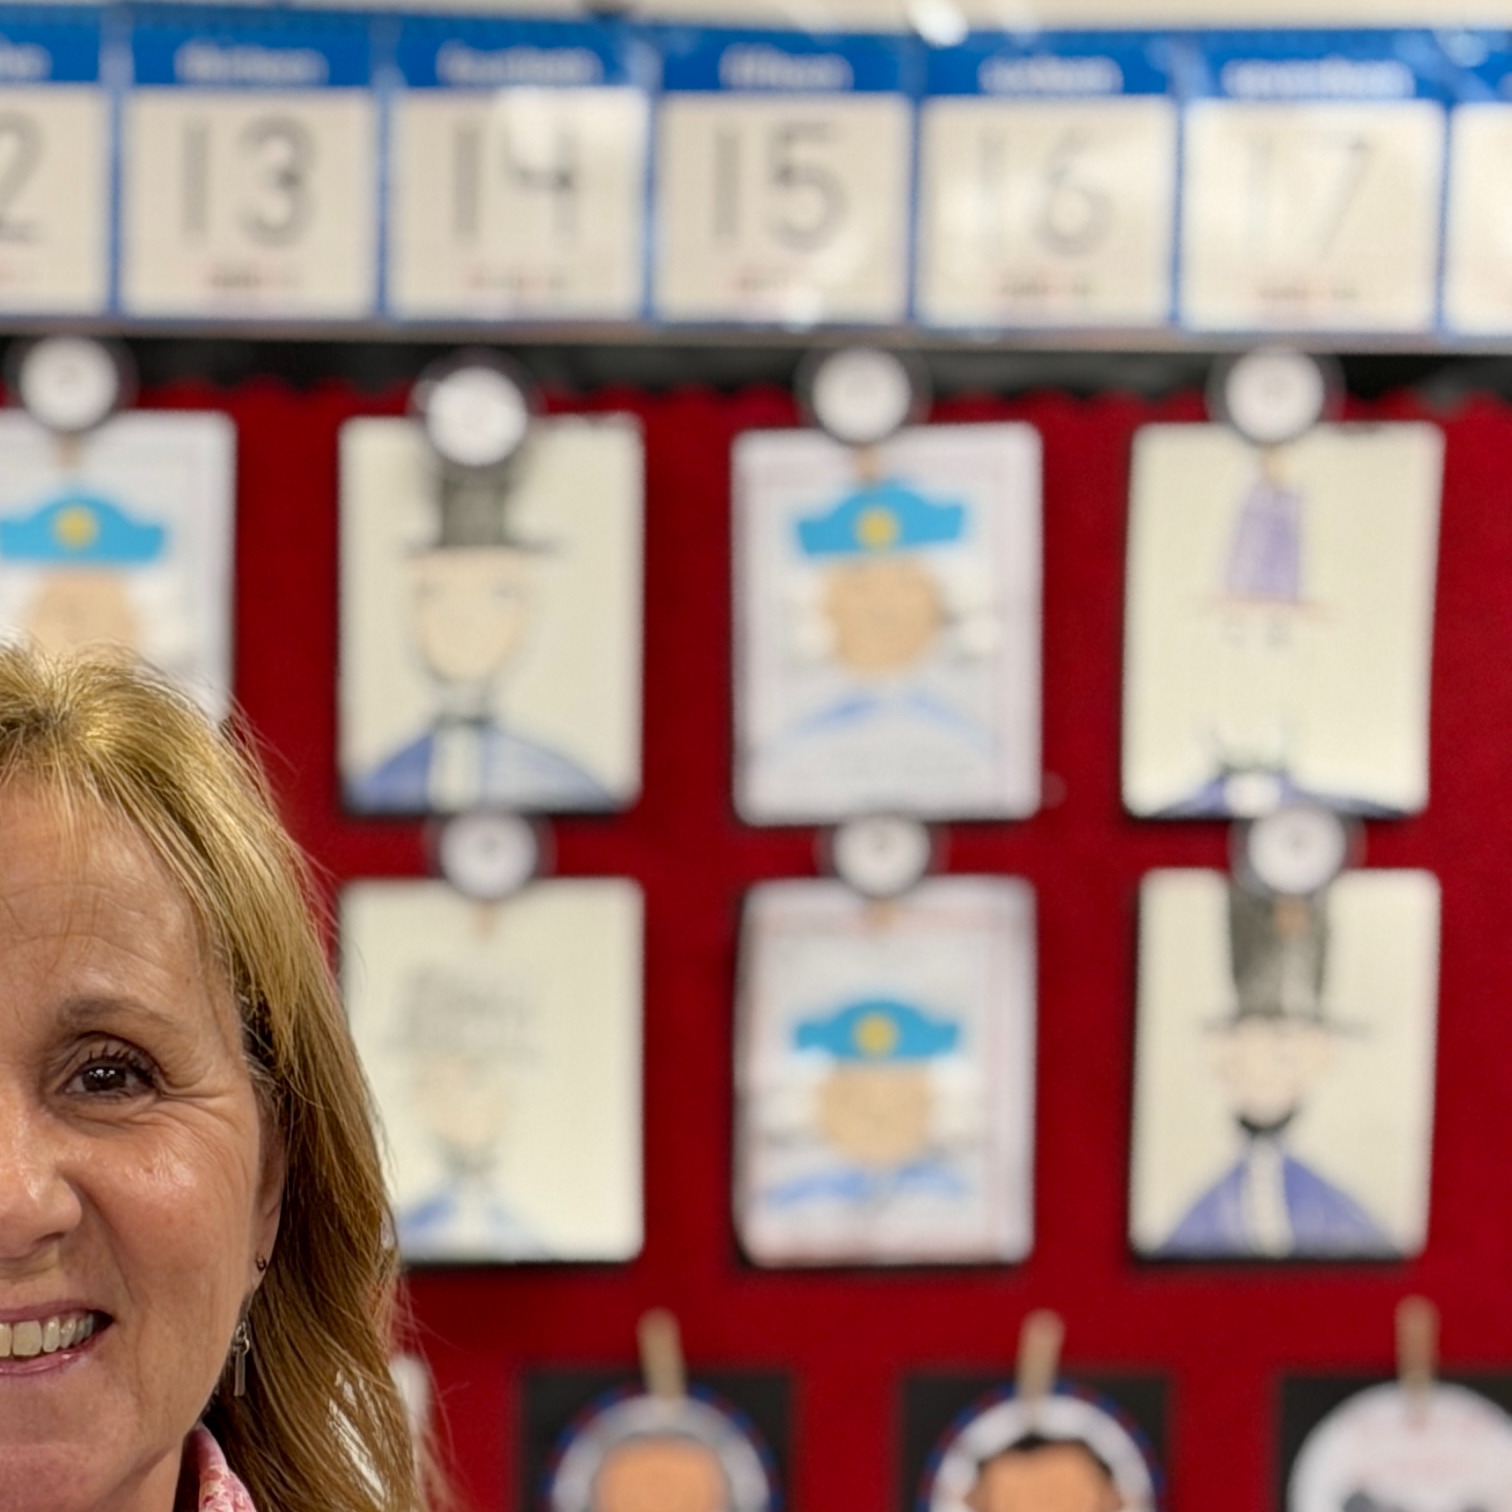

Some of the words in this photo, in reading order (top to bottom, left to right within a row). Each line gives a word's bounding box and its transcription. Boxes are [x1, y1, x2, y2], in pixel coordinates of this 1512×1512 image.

[180, 112, 318, 250] 13
[451, 112, 582, 250] 14
[712, 116, 850, 256] 15
[976, 124, 1114, 260] 16
[1246, 128, 1376, 264] 17
